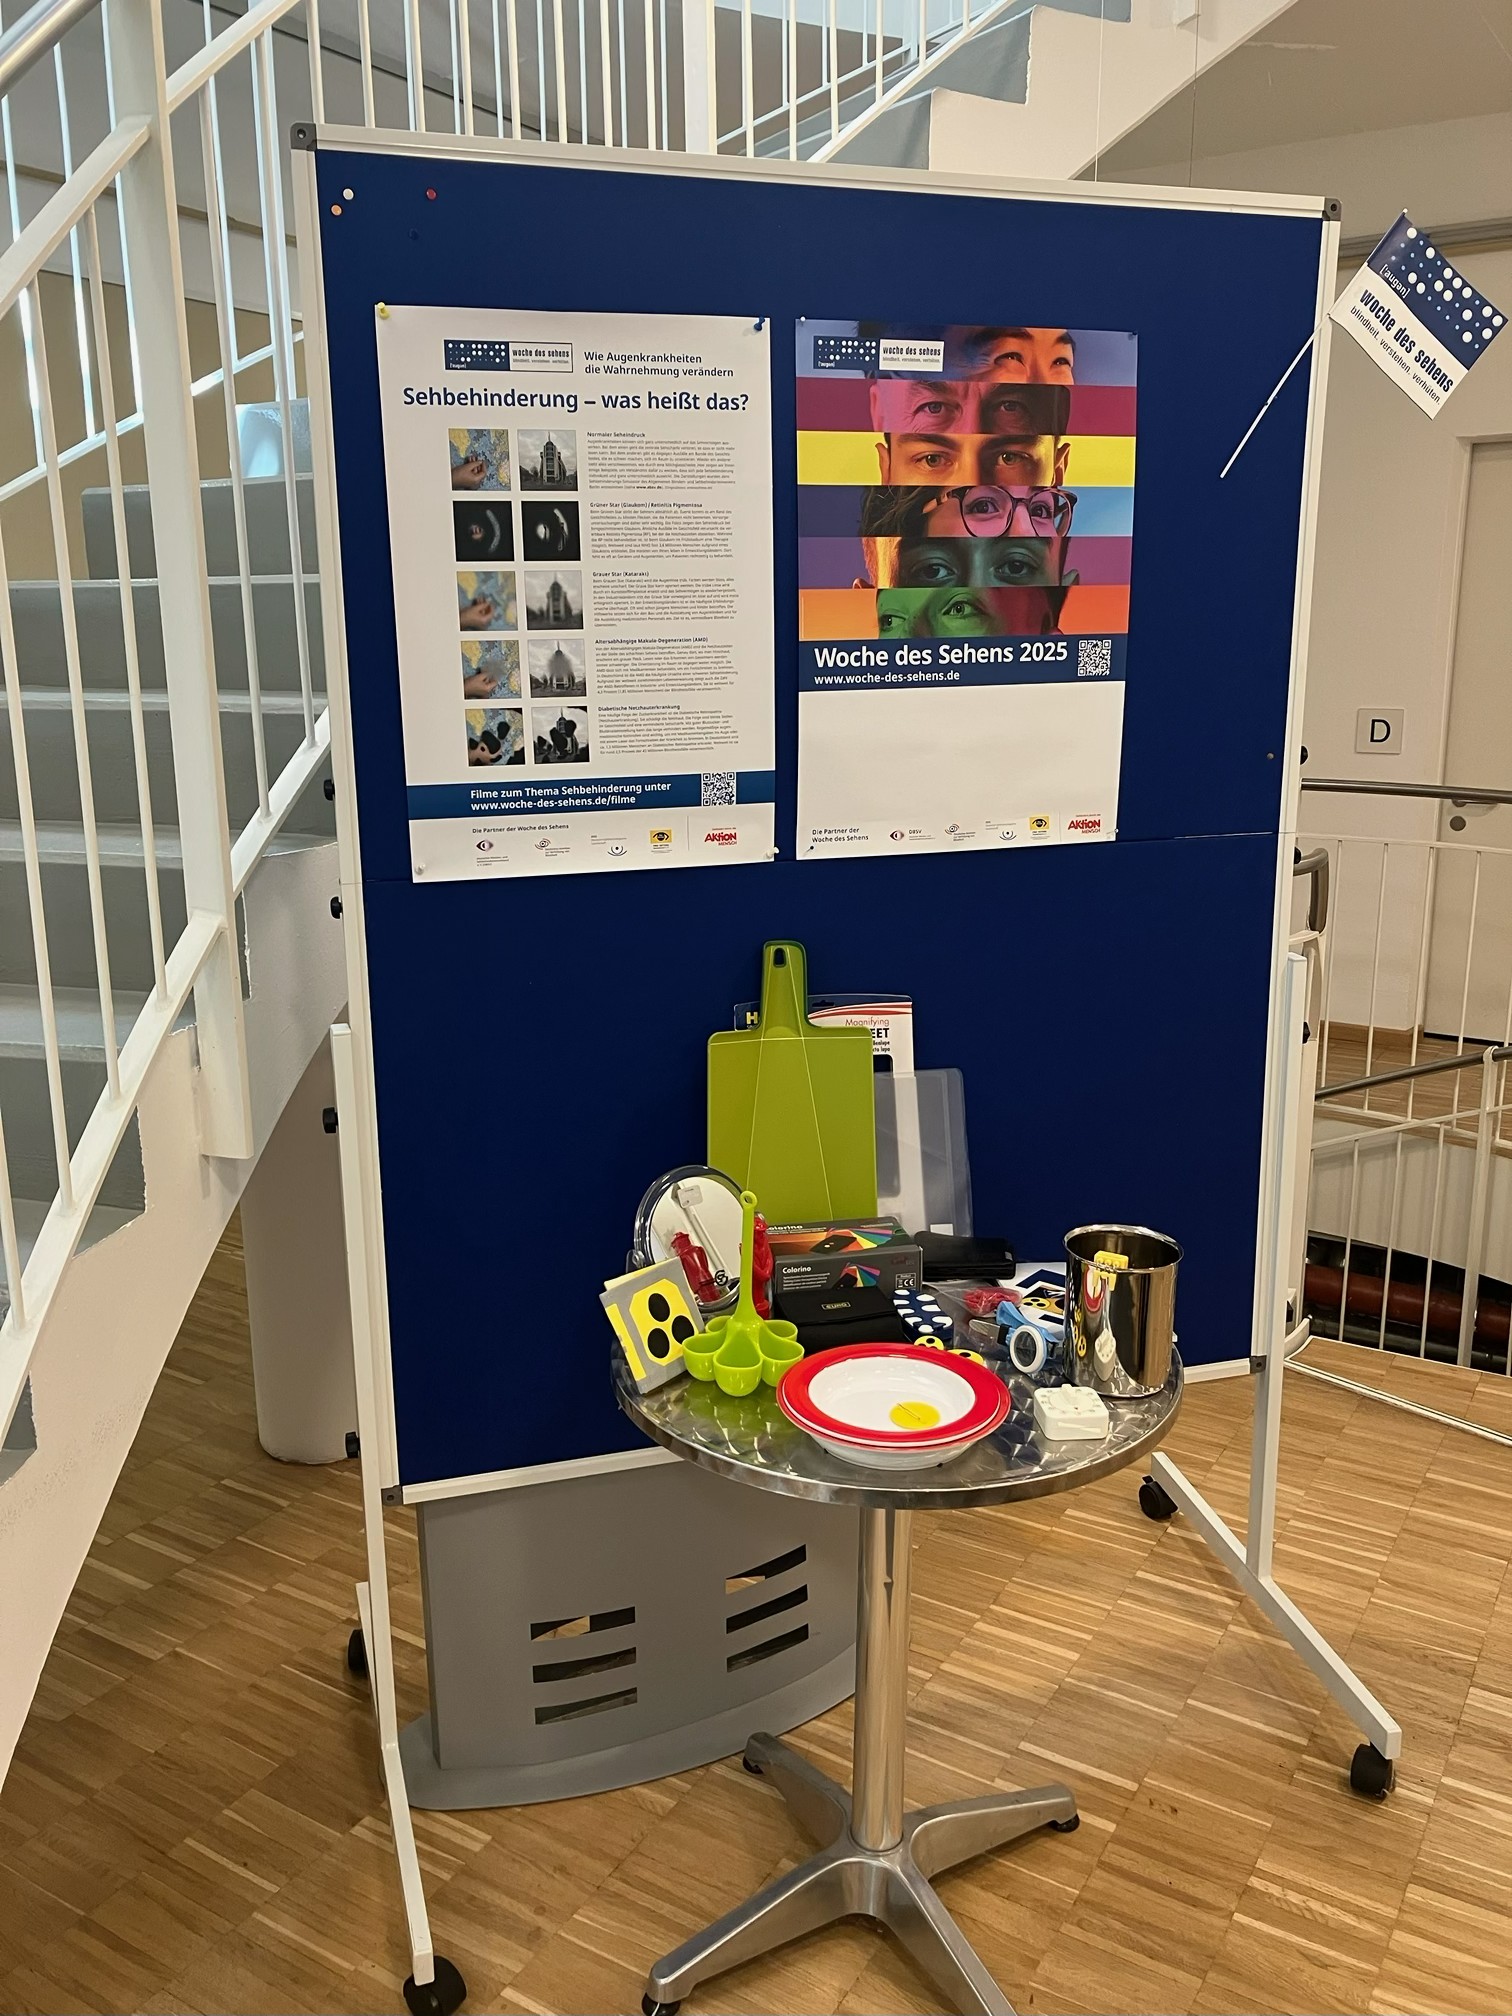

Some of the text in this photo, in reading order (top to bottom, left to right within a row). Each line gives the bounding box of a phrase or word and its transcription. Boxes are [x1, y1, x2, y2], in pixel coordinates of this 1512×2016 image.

[1360, 289, 1453, 392] woche des sehens
[512, 349, 569, 358] woche des sehens
[584, 352, 702, 364] Wie Augenkrankheiten
[883, 347, 941, 356] woche des sehens
[584, 365, 734, 378] die Wahrnehmung verändern
[403, 386, 578, 413] Sehbehinderung
[601, 395, 641, 409] was
[648, 391, 700, 410] heißt
[706, 392, 749, 411] das?
[814, 642, 1068, 668] Woche des Sehens 2025
[814, 670, 960, 685] www.woche-des-sehens.de
[1370, 719, 1391, 742] D
[471, 782, 671, 799] Filme zum Thema Sehbehinderung unter
[471, 795, 636, 811] www.woche-des-sehens.de/filme
[846, 1016, 889, 1026] Magnifying
[870, 1028, 889, 1038] EET
[782, 1266, 812, 1274] Colorino
